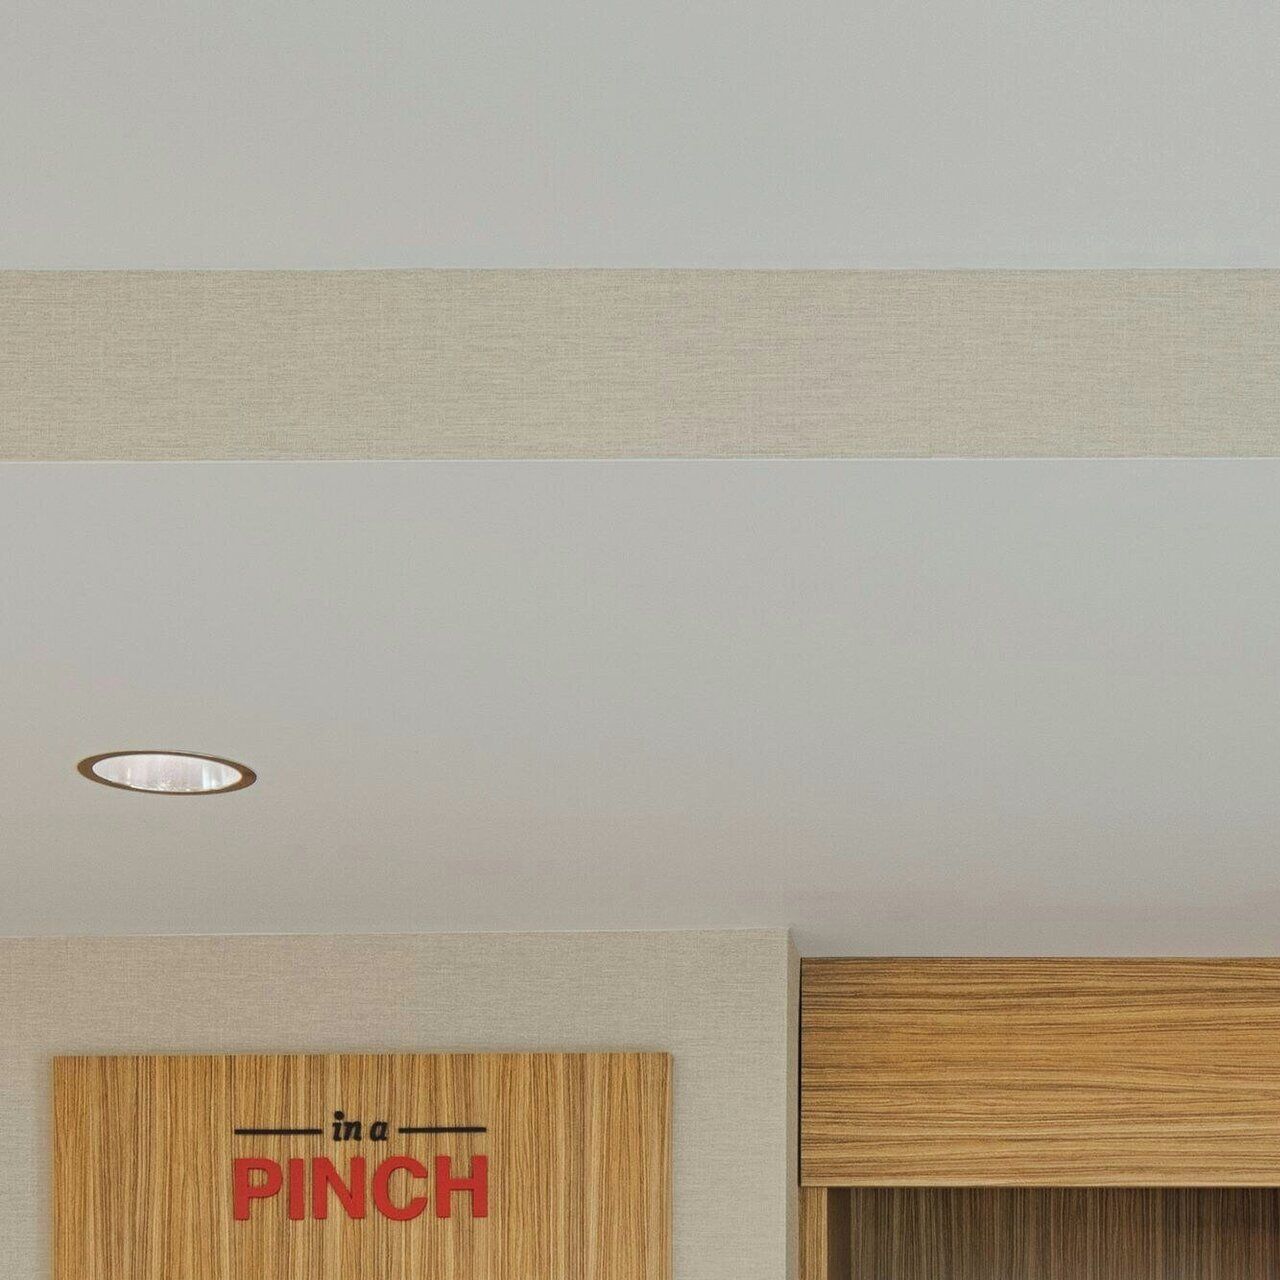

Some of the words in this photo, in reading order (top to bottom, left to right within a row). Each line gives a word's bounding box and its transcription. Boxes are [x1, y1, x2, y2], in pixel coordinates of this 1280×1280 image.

[331, 1110, 362, 1142] in
[369, 1119, 388, 1142] a
[233, 1155, 488, 1221] PINCH
